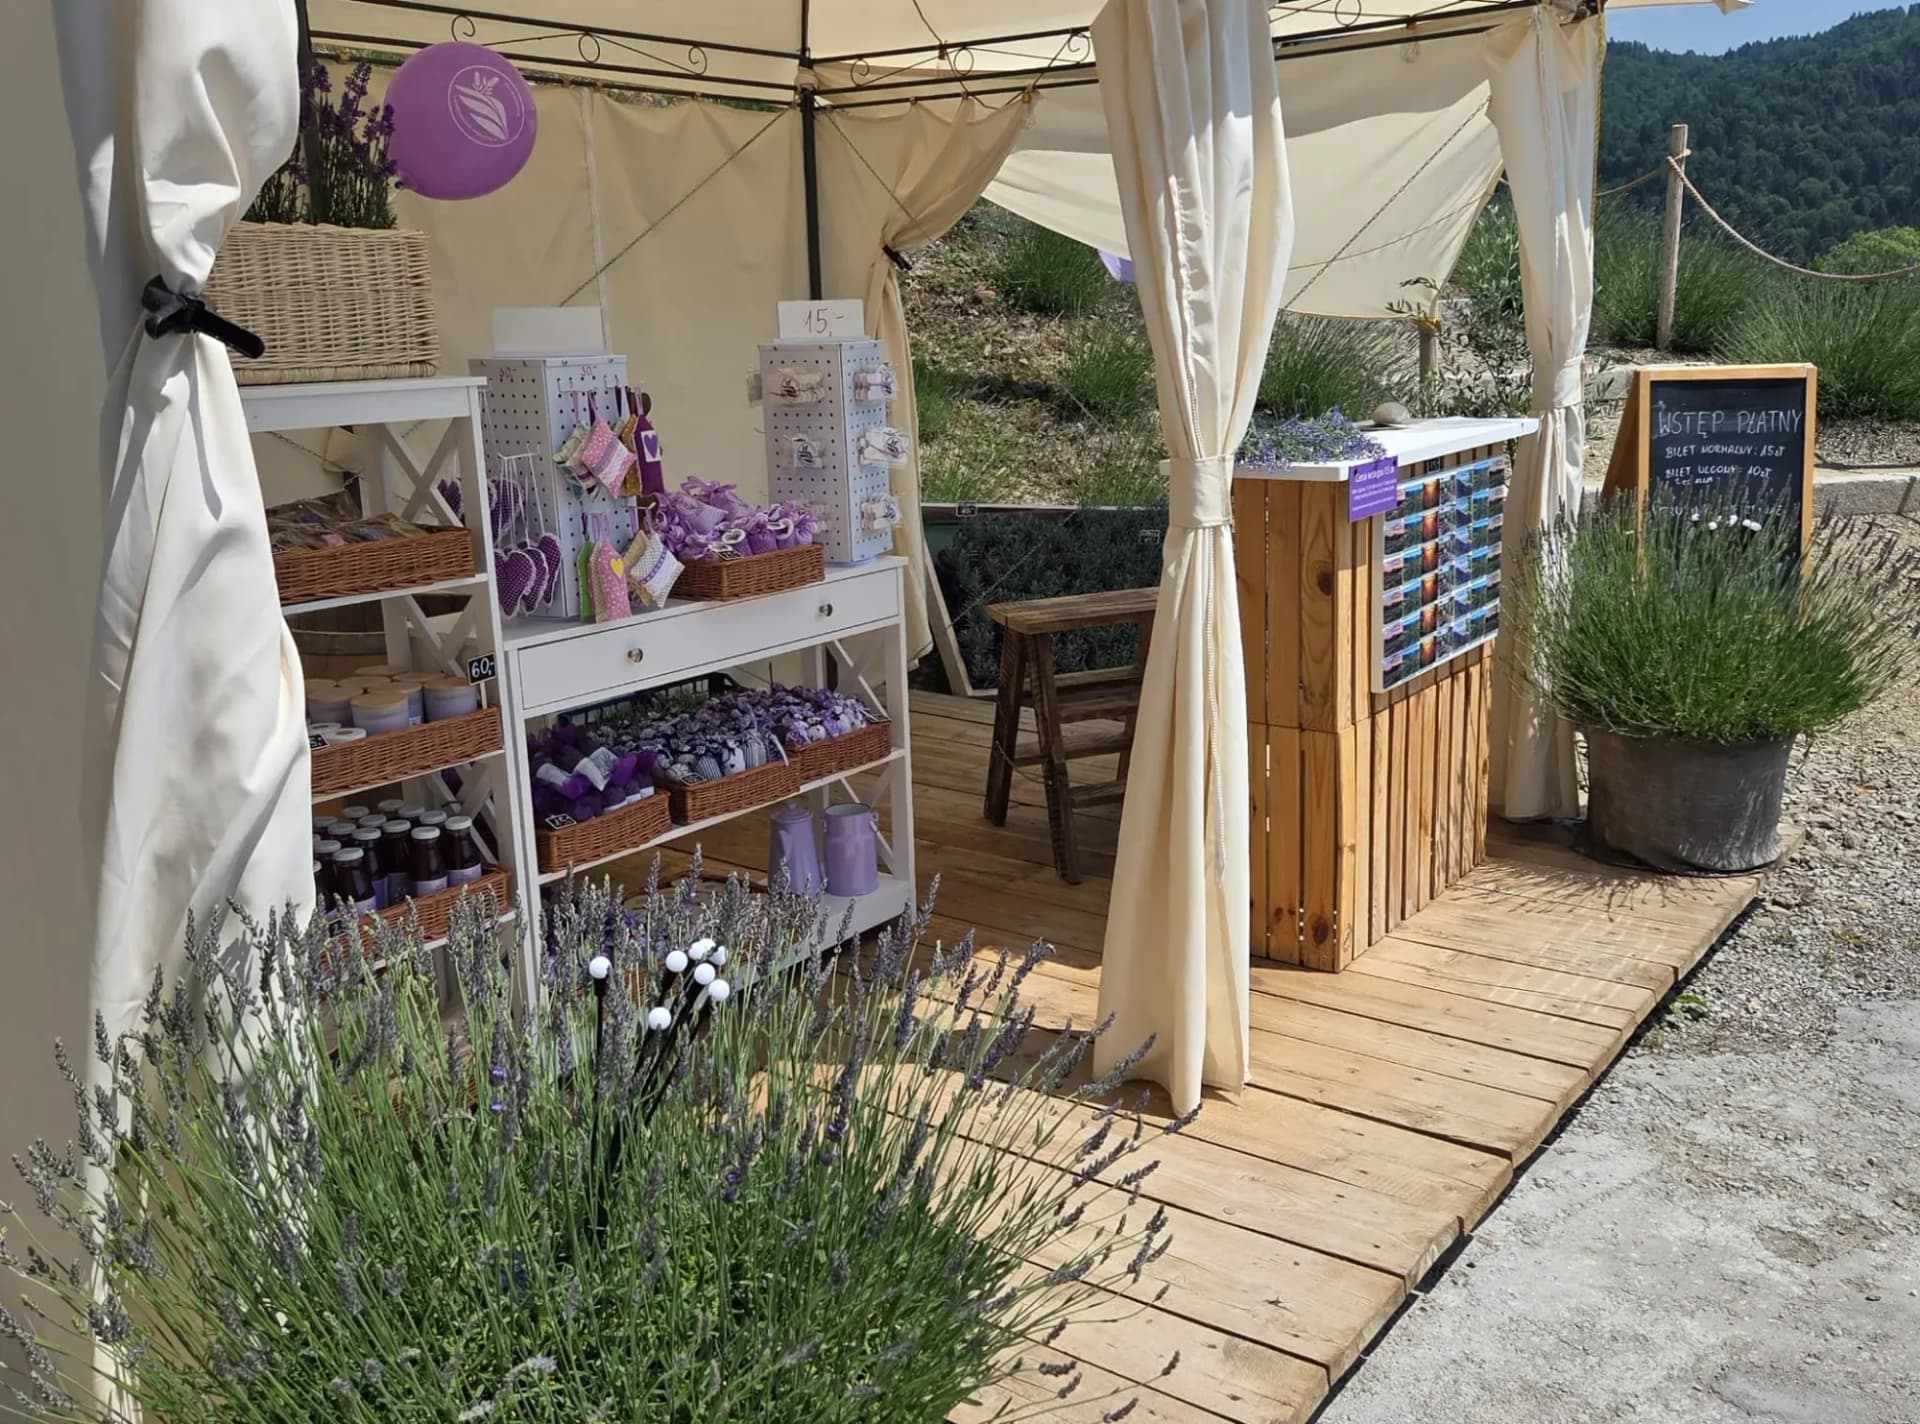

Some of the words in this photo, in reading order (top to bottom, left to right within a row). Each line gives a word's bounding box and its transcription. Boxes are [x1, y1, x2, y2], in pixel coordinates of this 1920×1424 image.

[804, 308, 845, 337] 15,-
[1658, 410, 1725, 438] WSTĘP
[1737, 408, 1803, 434] PŁATNY
[1665, 445, 1697, 458] BILET
